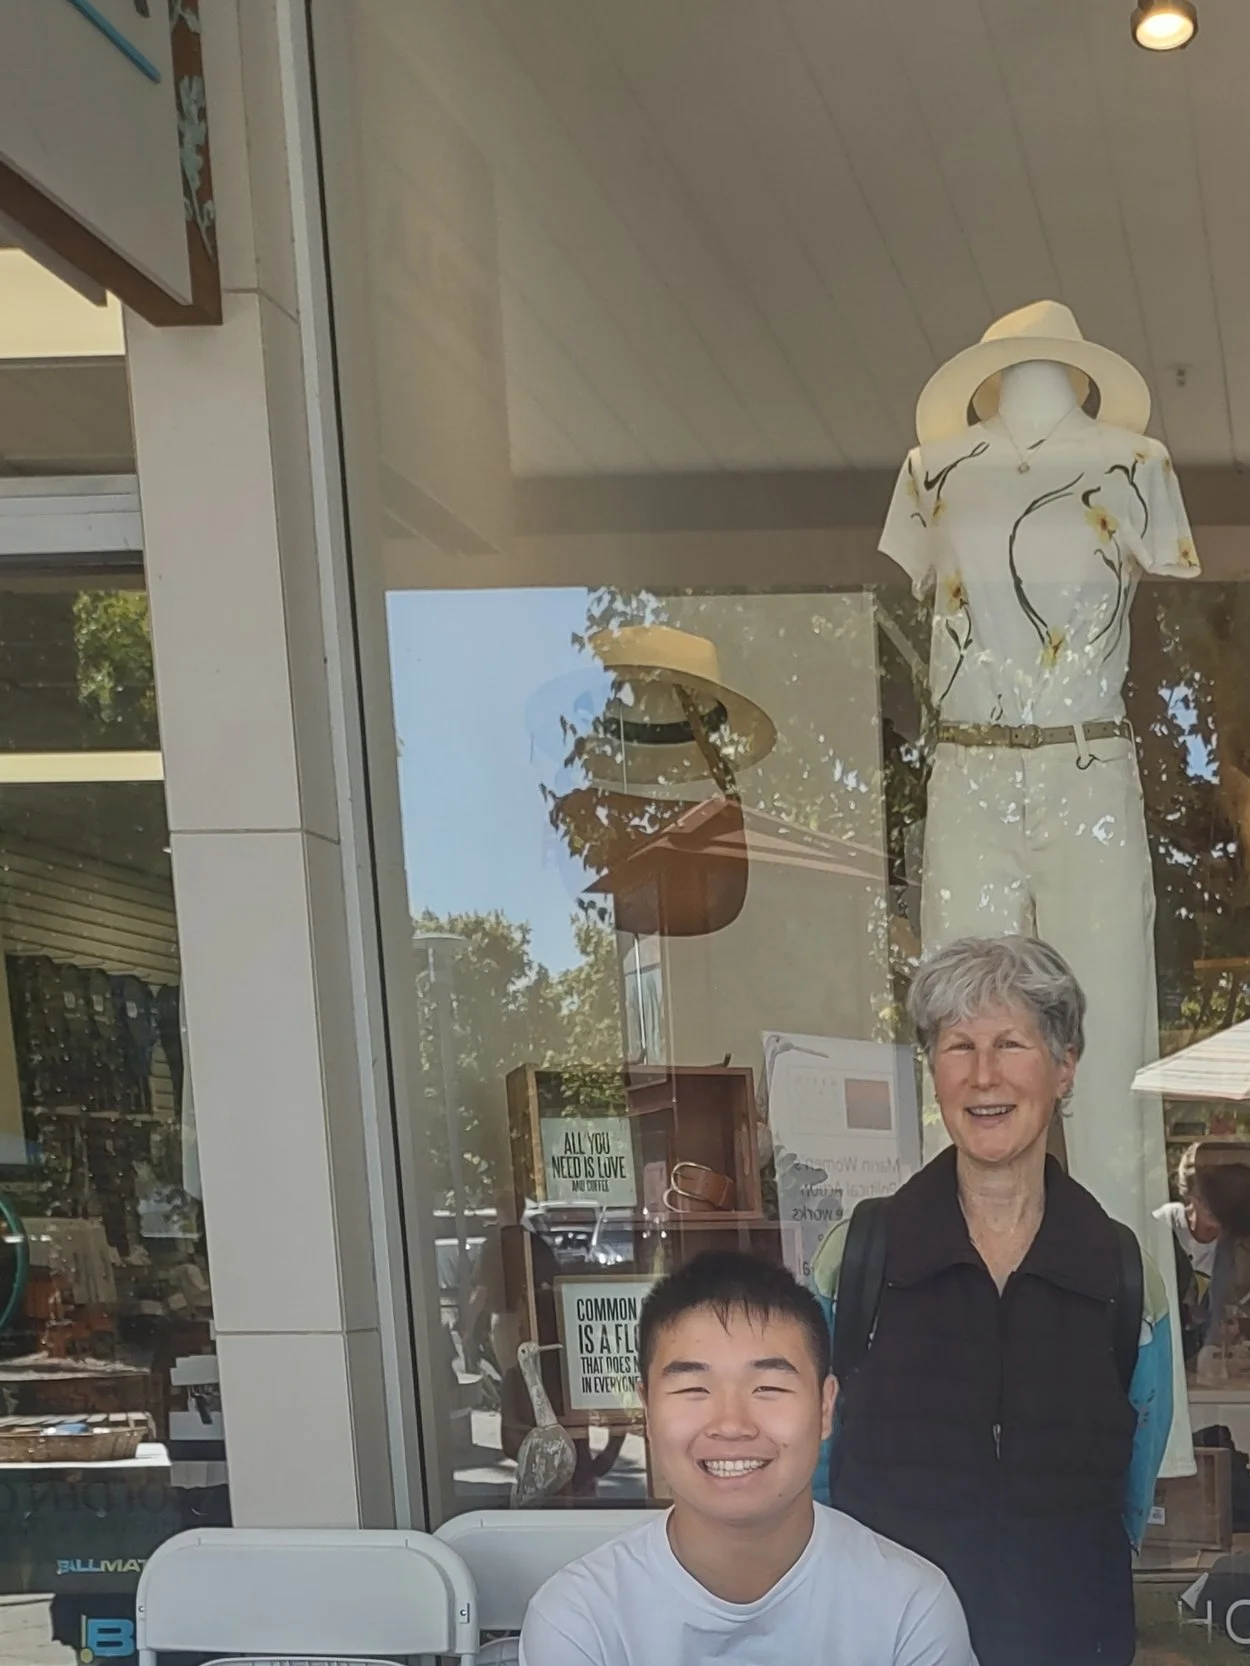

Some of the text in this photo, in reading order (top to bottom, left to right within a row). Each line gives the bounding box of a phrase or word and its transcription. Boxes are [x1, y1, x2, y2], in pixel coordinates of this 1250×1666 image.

[564, 1131, 609, 1155] ALL YOU
[551, 1156, 626, 1180] NEED IS LOVE
[572, 1179, 609, 1192] AND COFFEE
[577, 1297, 637, 1321] COMMON
[578, 1324, 595, 1354] IS
[600, 1324, 611, 1354] A
[581, 1356, 603, 1374] THAT
[606, 1356, 631, 1374] DOES
[582, 1377, 592, 1393] IN
